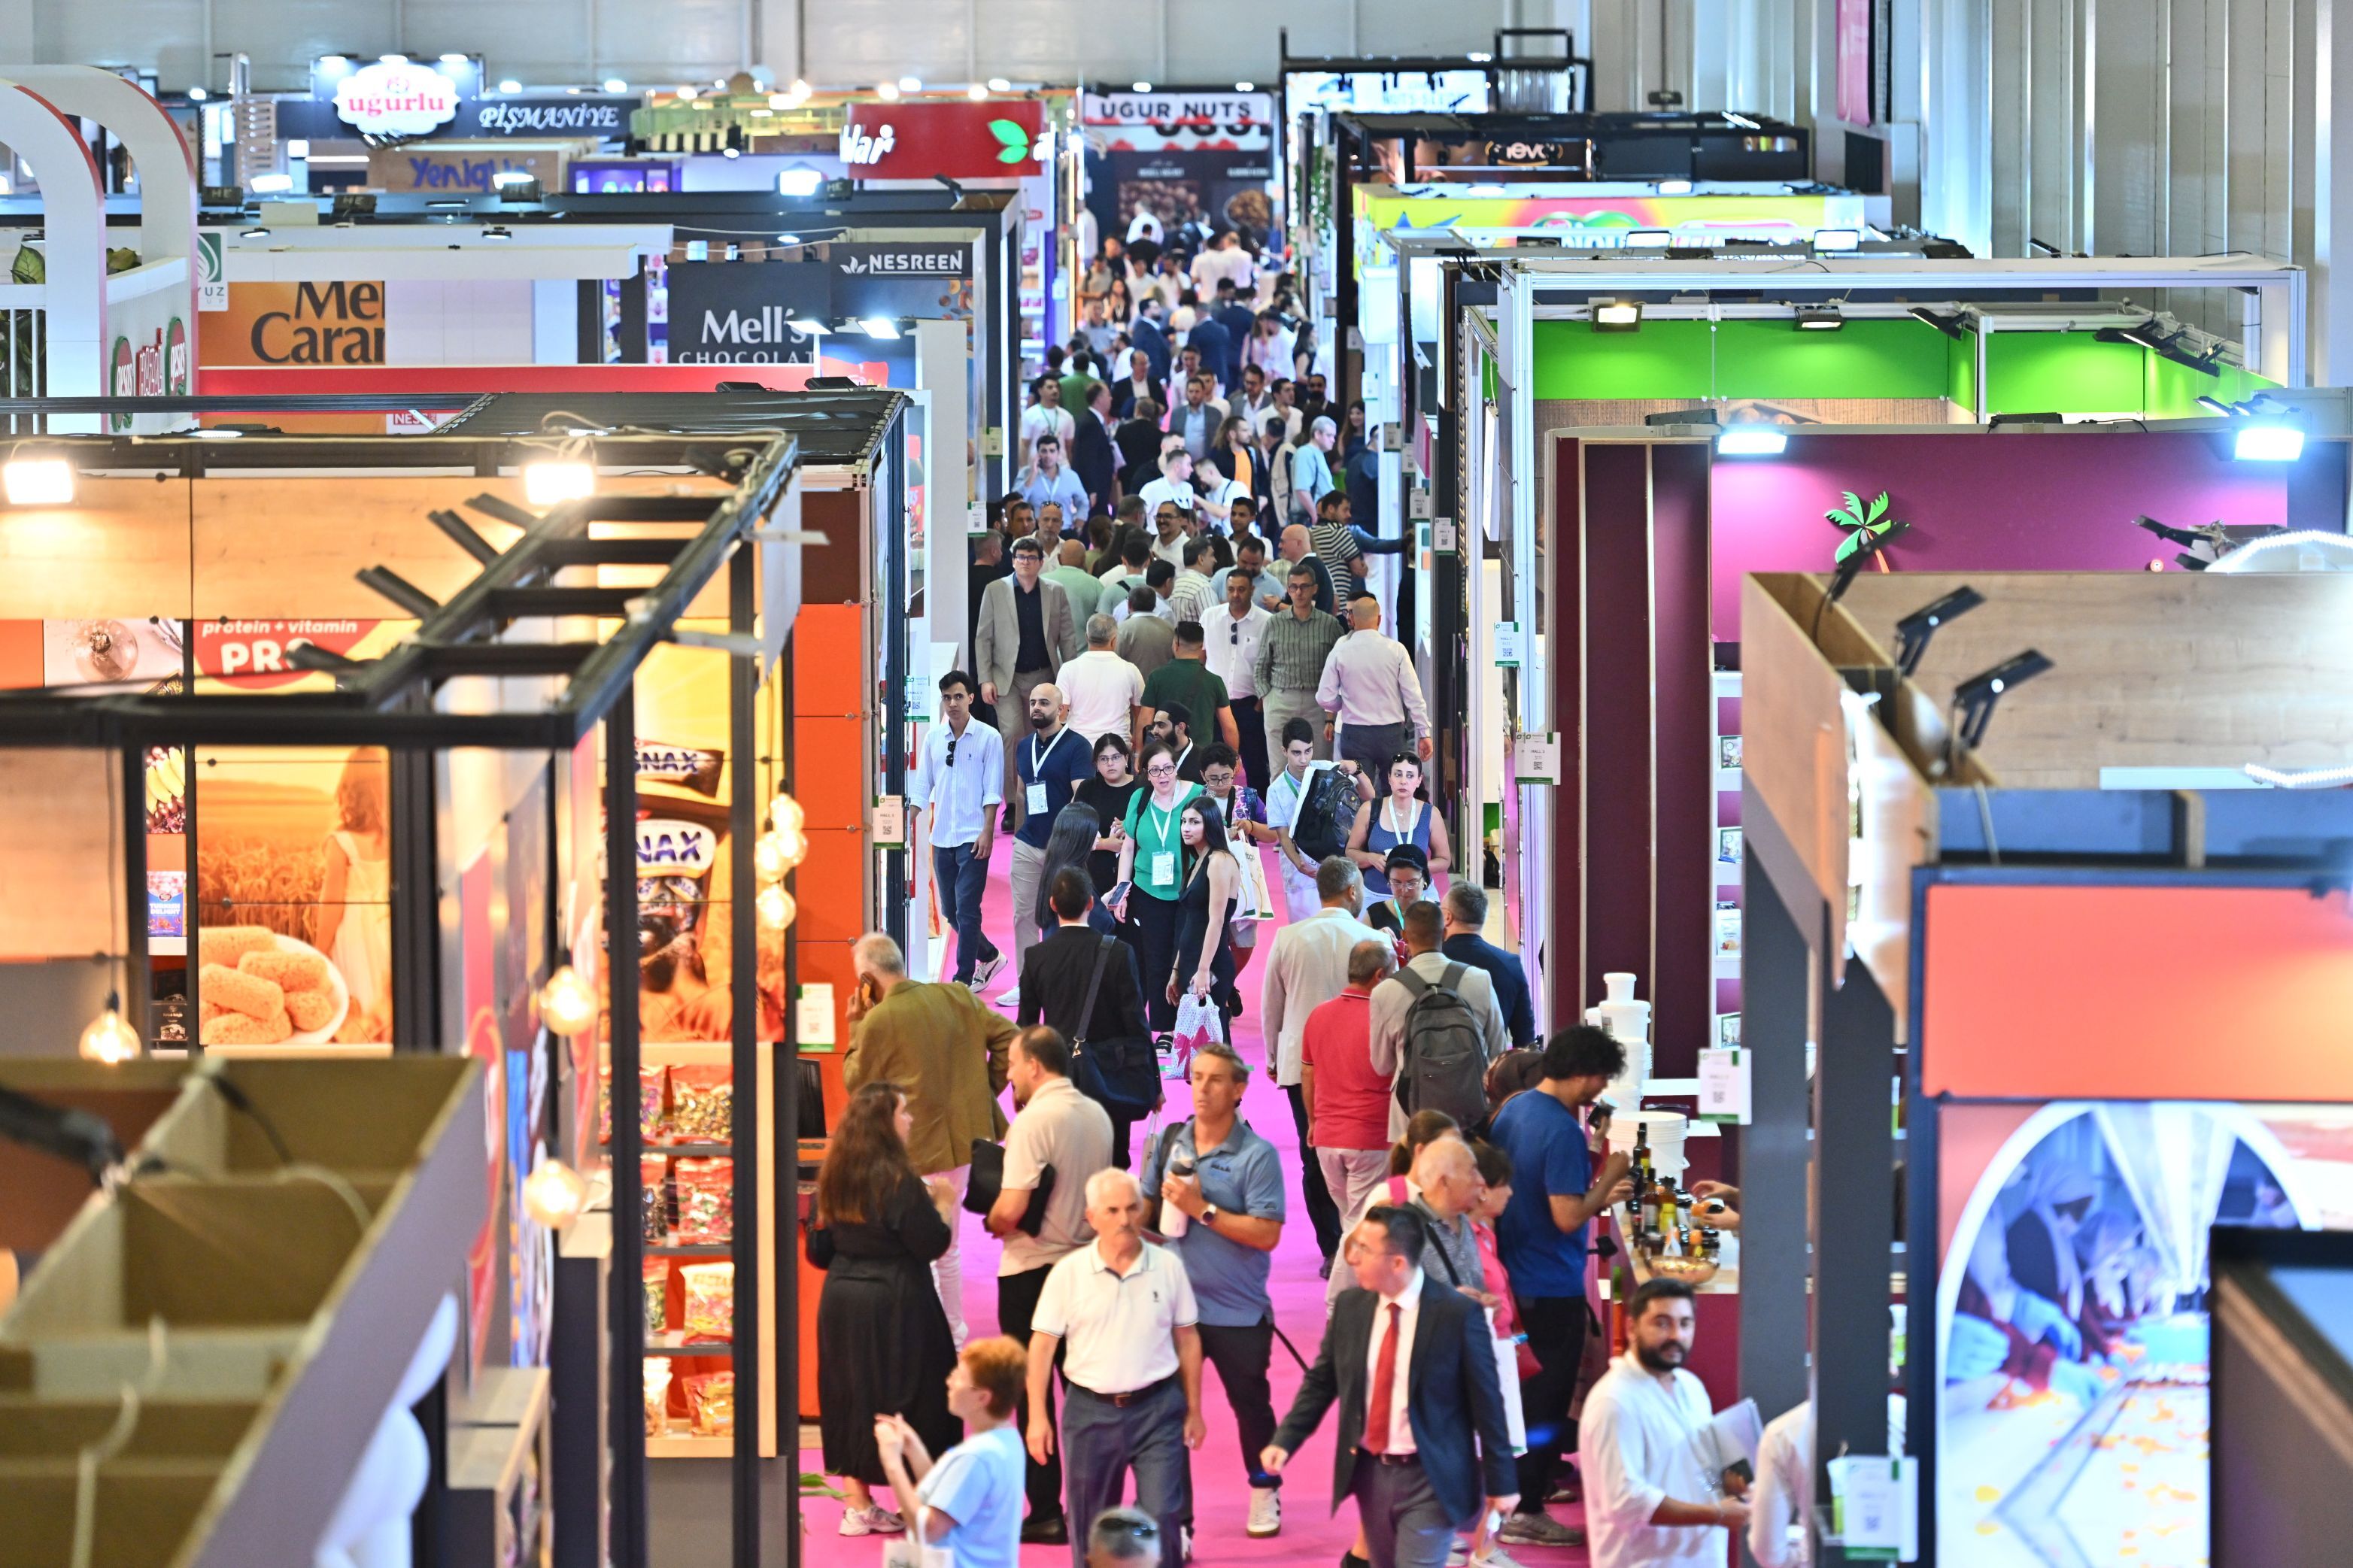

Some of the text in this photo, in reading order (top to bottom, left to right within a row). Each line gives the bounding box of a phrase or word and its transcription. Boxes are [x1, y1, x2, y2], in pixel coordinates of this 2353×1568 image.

[1101, 102, 1252, 117] UGUR NUTS
[479, 102, 619, 133] PİŞMANİYE
[212, 189, 232, 198] HE
[343, 195, 364, 205] HE
[870, 250, 963, 274] NESREEN
[198, 287, 225, 296] UZ
[202, 620, 270, 638] protein
[288, 620, 357, 633] vitamin
